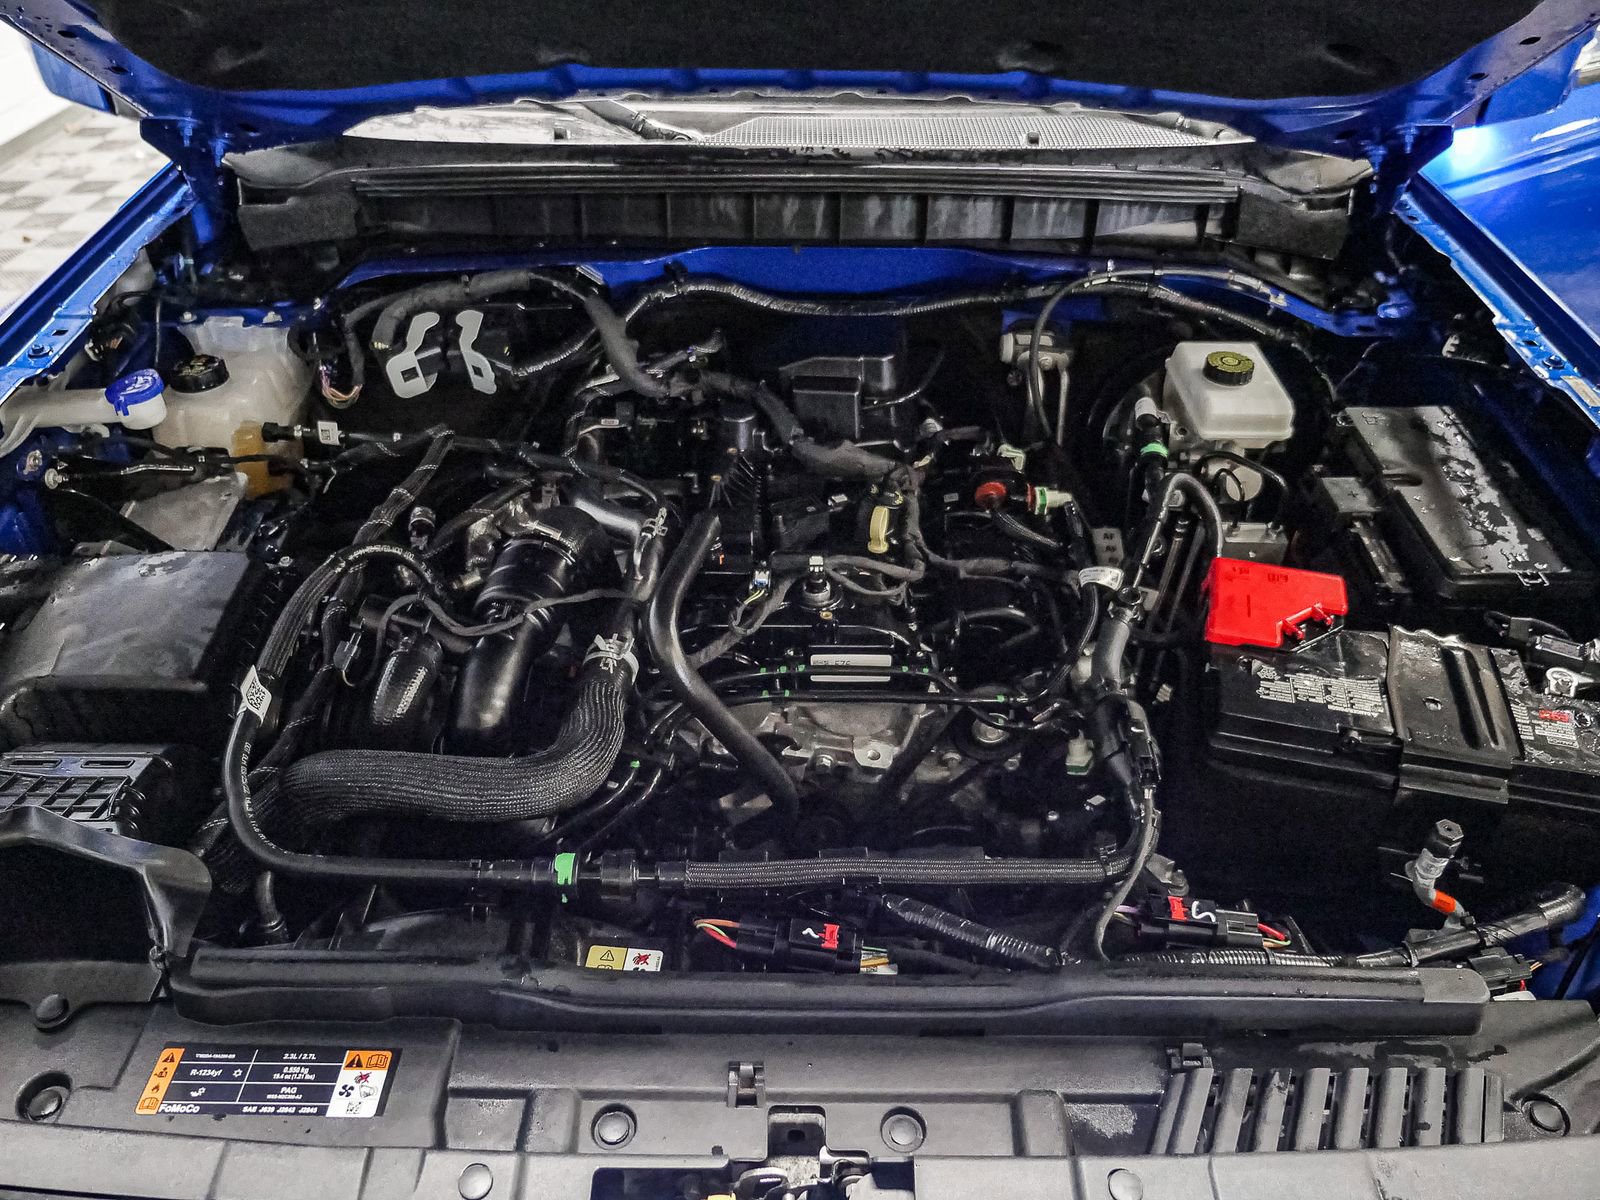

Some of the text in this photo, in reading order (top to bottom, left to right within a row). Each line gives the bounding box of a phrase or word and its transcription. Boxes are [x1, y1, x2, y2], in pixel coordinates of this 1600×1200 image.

[189, 1068, 223, 1078] R-1234yf
[280, 1086, 298, 1094] PAG
[158, 1104, 200, 1113] FoMoCo
